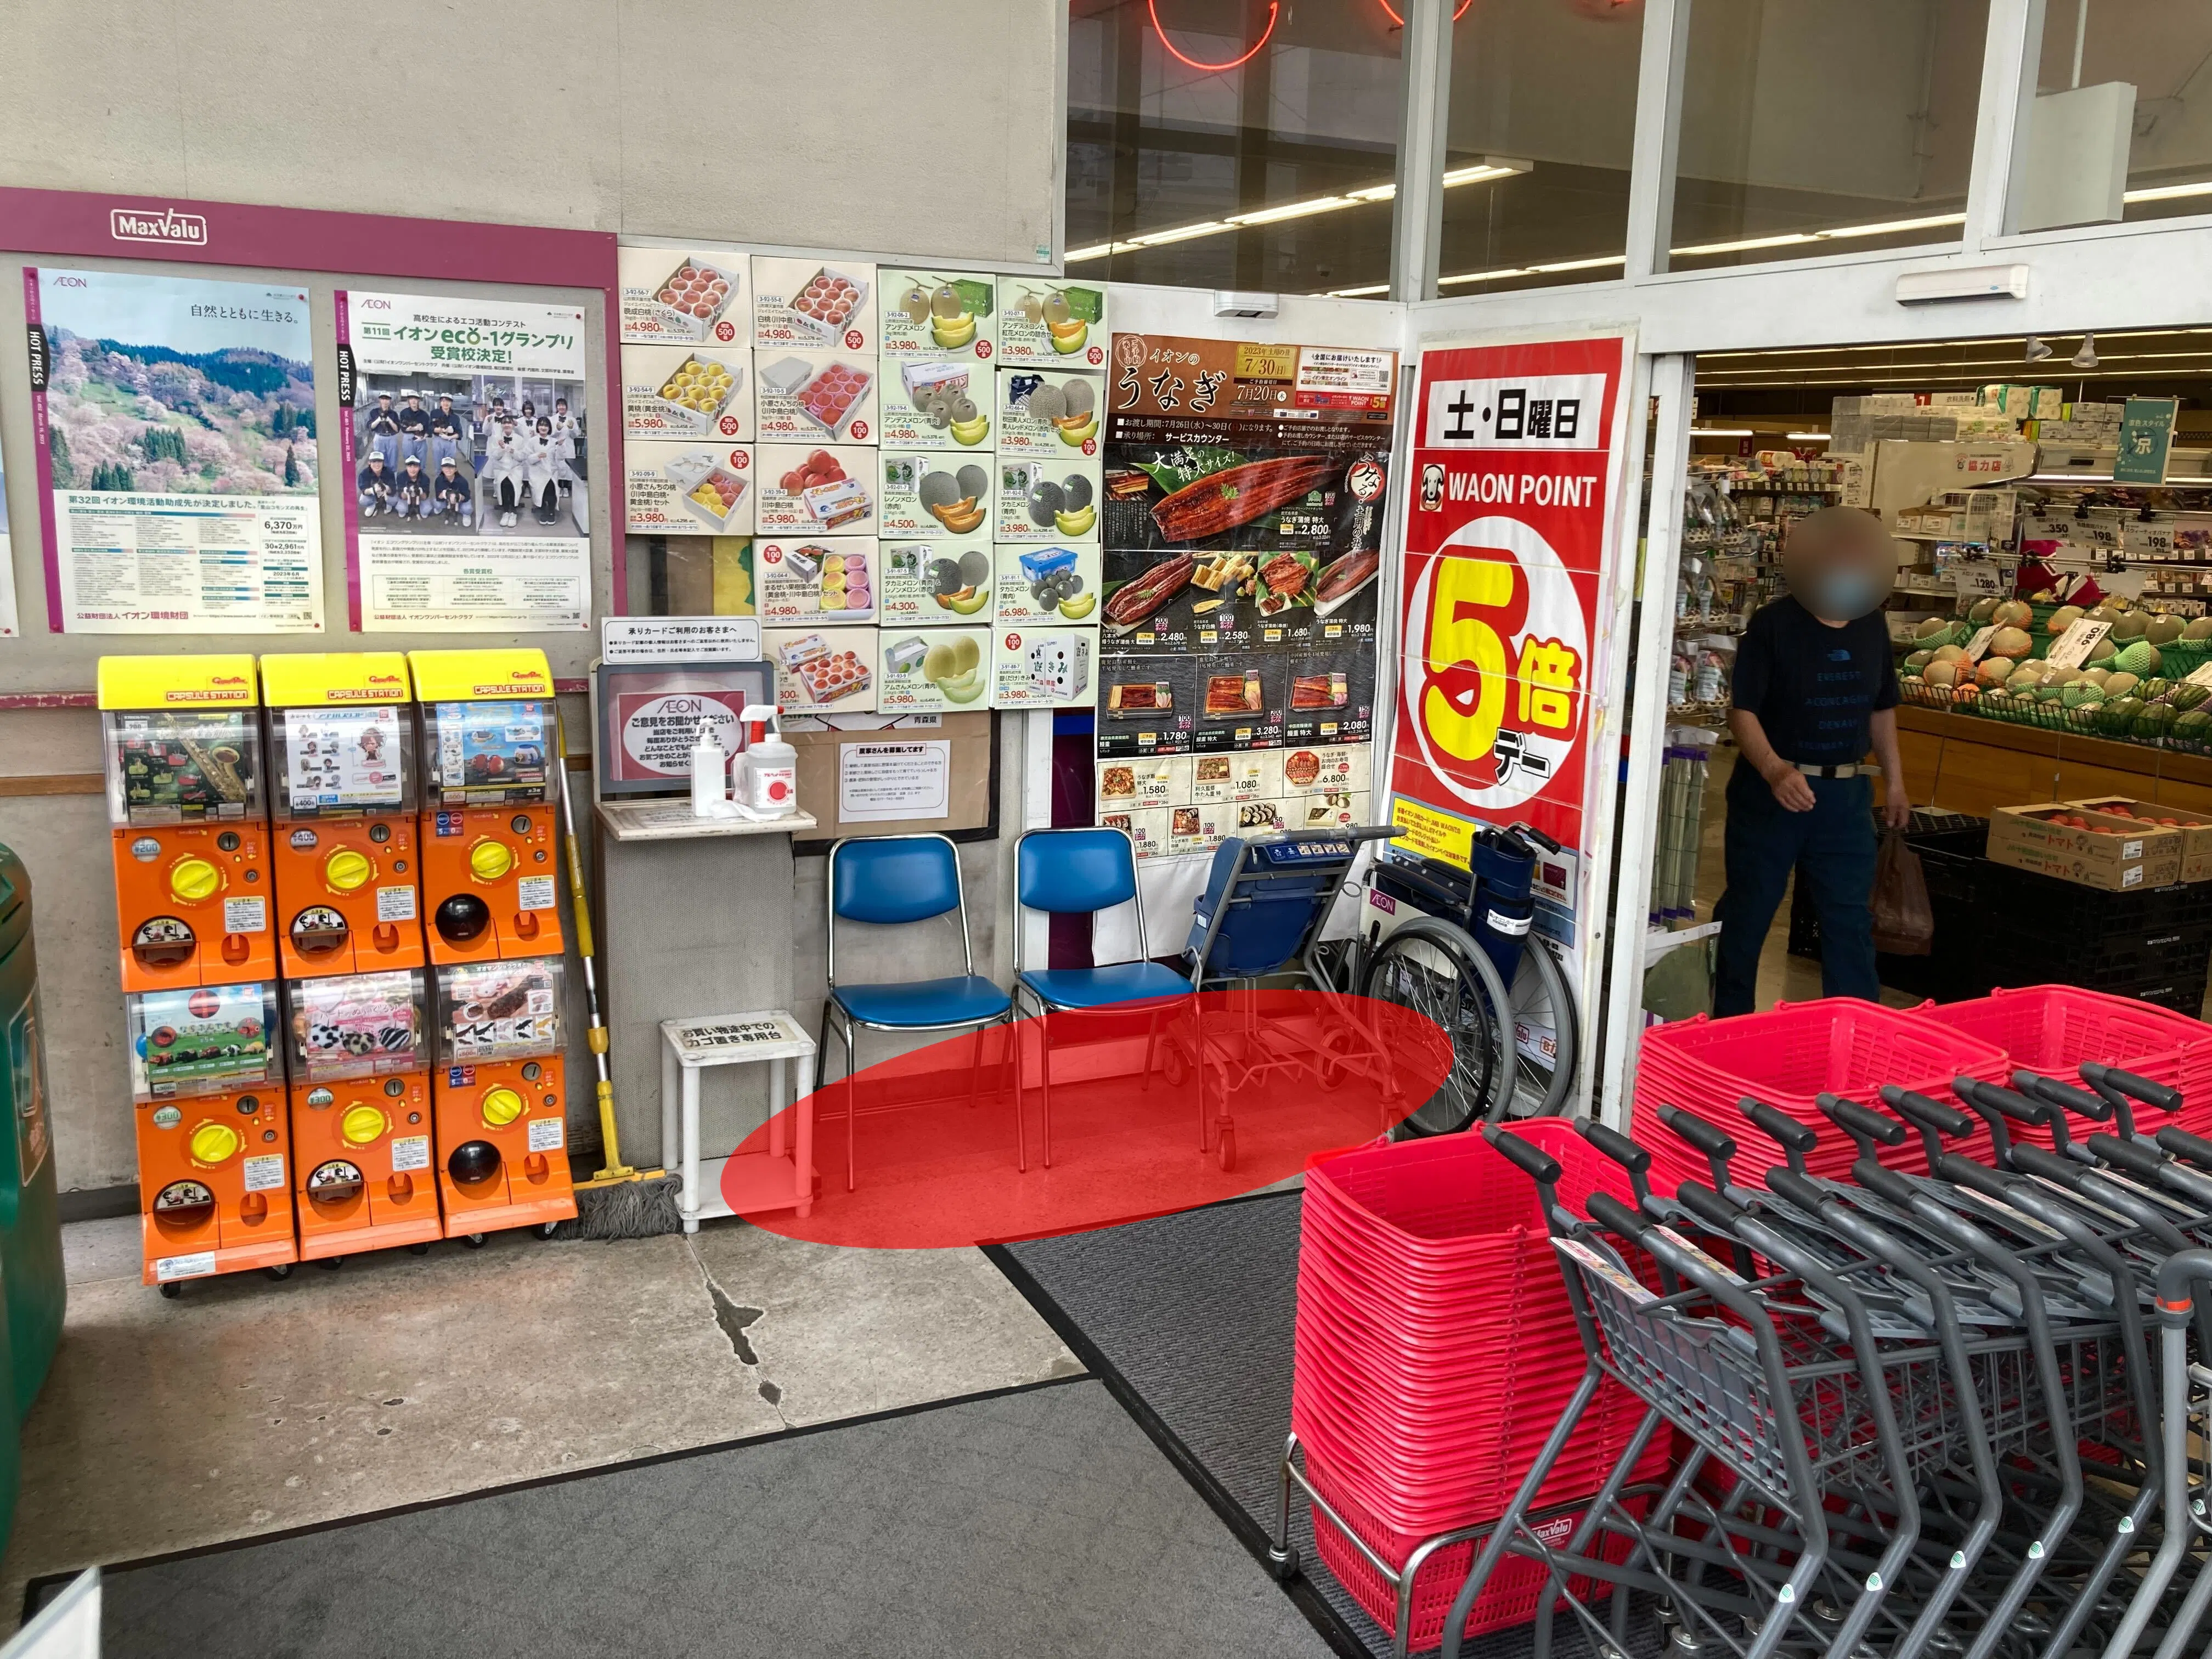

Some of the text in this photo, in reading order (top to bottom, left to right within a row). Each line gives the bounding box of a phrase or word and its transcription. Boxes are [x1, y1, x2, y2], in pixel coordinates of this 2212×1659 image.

[119, 207, 200, 239] MaxValu
[191, 304, 299, 324] 自然とともに生きる。
[413, 314, 526, 329] 高校生によるエコ活動コンテスト
[30, 331, 41, 353] HOT
[340, 350, 348, 370] HOT
[431, 346, 512, 364] 受賞校決定!
[1150, 348, 1200, 365] イオンの
[31, 354, 43, 385] PRESS
[1245, 358, 1285, 375] 7/30(日)
[341, 371, 350, 401] PRESS
[1118, 366, 1227, 412] うなぎ
[1443, 388, 1580, 439] 土・日曜日
[1165, 433, 1229, 443] サービスカウンター
[1448, 471, 1597, 507] WAON POINT
[69, 495, 100, 504] 第32回
[264, 521, 303, 530] 6,370万円
[2049, 524, 2068, 533] 350
[2093, 530, 2112, 541] 198
[2148, 535, 2166, 548] 198
[77, 611, 188, 620] 公益財団法人 イオン環境財団
[628, 627, 737, 635] 承りカードご利用のお客さまへ
[167, 691, 247, 701] CAPSULE STATION
[328, 689, 403, 699] CAPSULE STATION
[475, 684, 545, 695] CAPSULE STATION
[632, 714, 735, 727] ご意見をお聞かせださい
[2047, 834, 2075, 850] トマト
[2044, 860, 2071, 877] トマト
